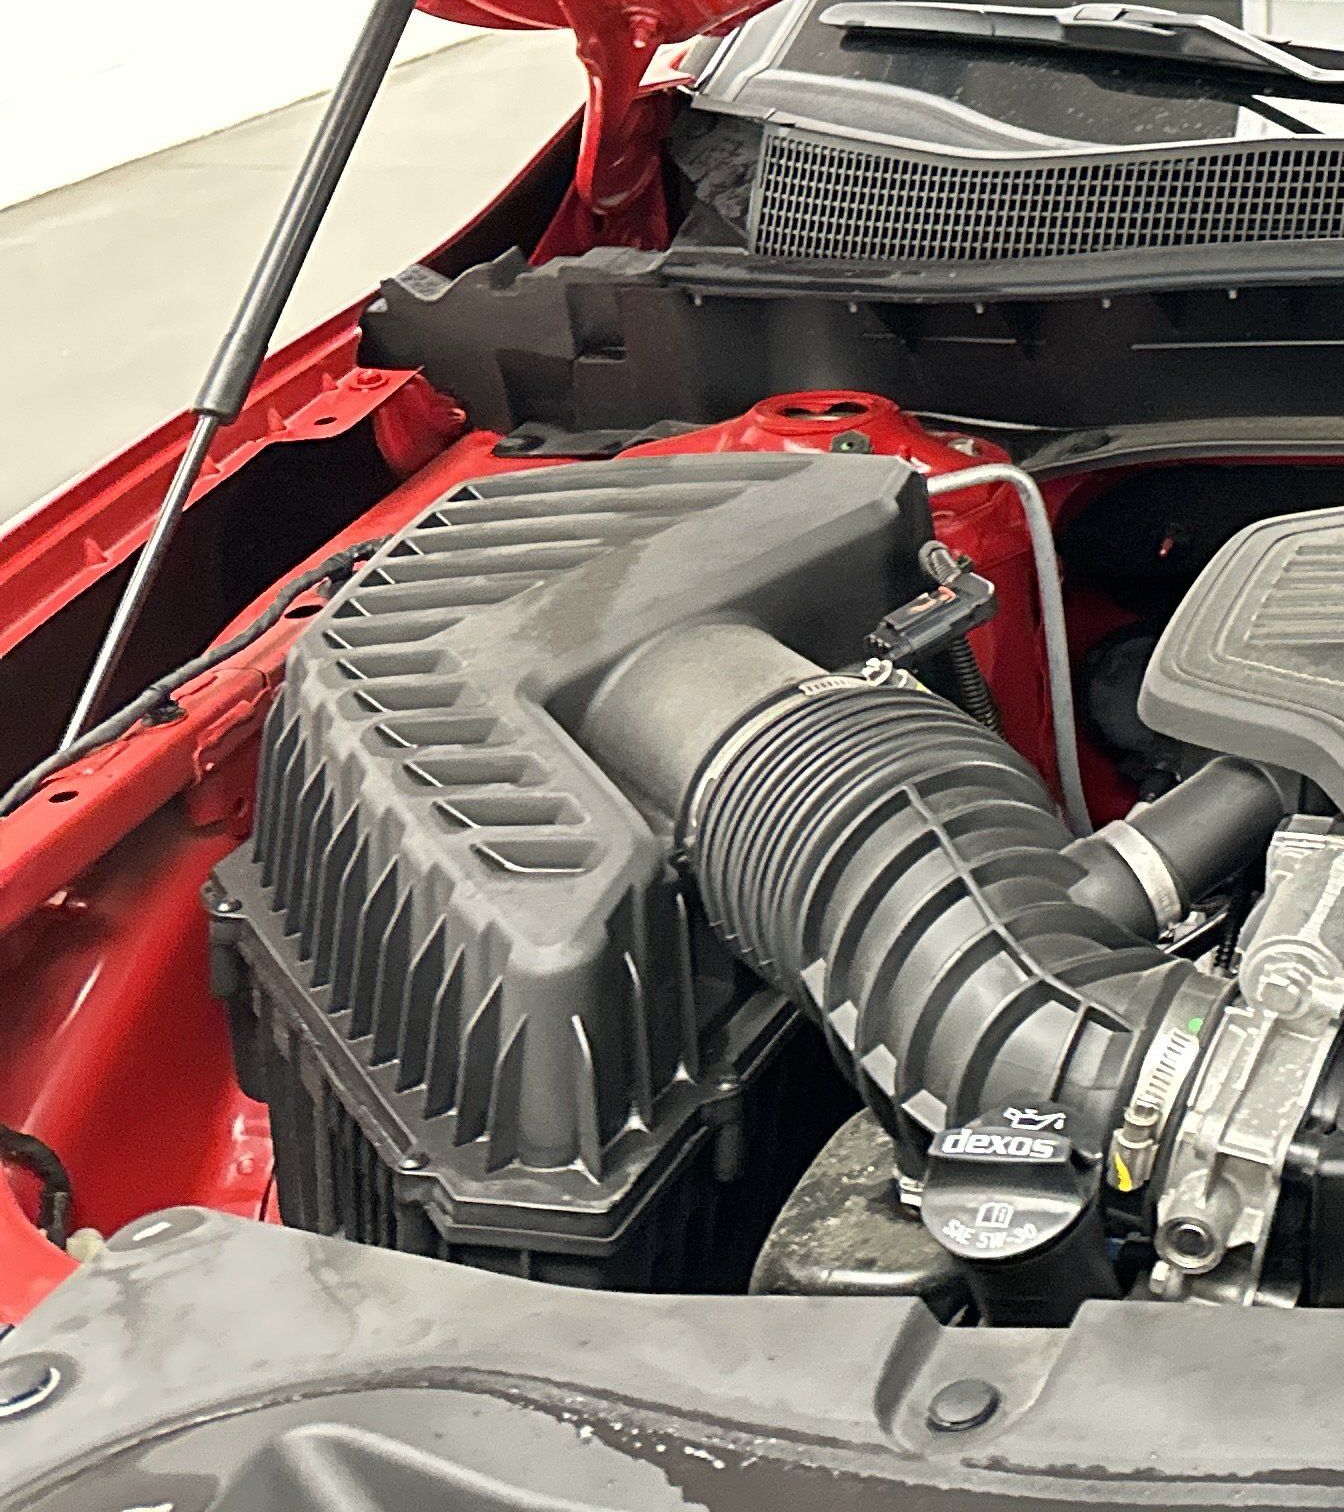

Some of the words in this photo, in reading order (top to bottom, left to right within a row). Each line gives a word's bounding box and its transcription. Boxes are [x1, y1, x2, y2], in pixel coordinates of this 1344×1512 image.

[942, 1128, 1060, 1159] dexos
[942, 1219, 976, 1246] SAE
[975, 1223, 1038, 1249] 5W-30
